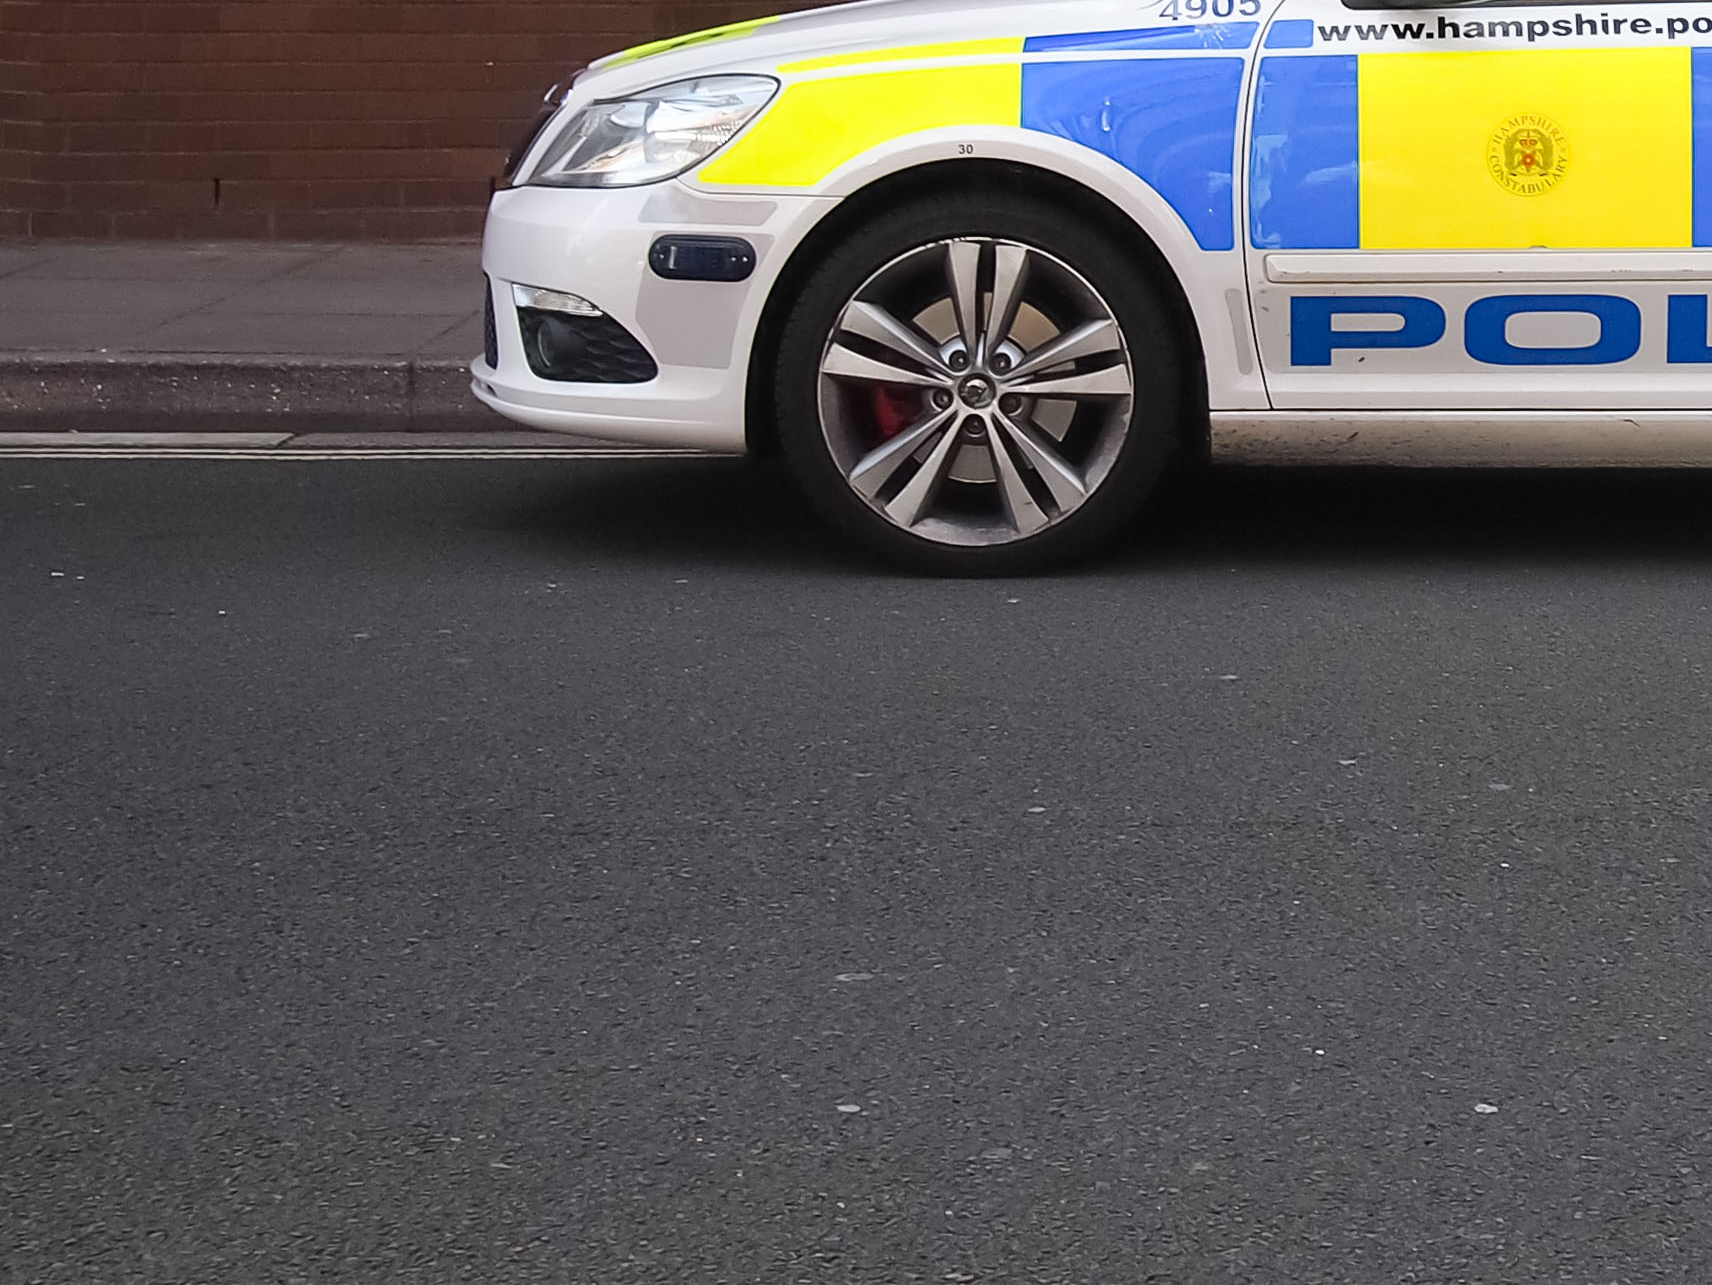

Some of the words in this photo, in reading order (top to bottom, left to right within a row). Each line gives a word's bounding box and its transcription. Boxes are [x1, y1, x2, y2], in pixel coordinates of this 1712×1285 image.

[1491, 115, 1566, 146] HAMPSHIRE
[958, 144, 974, 154] 30
[1489, 155, 1568, 194] CONSTABULARY
